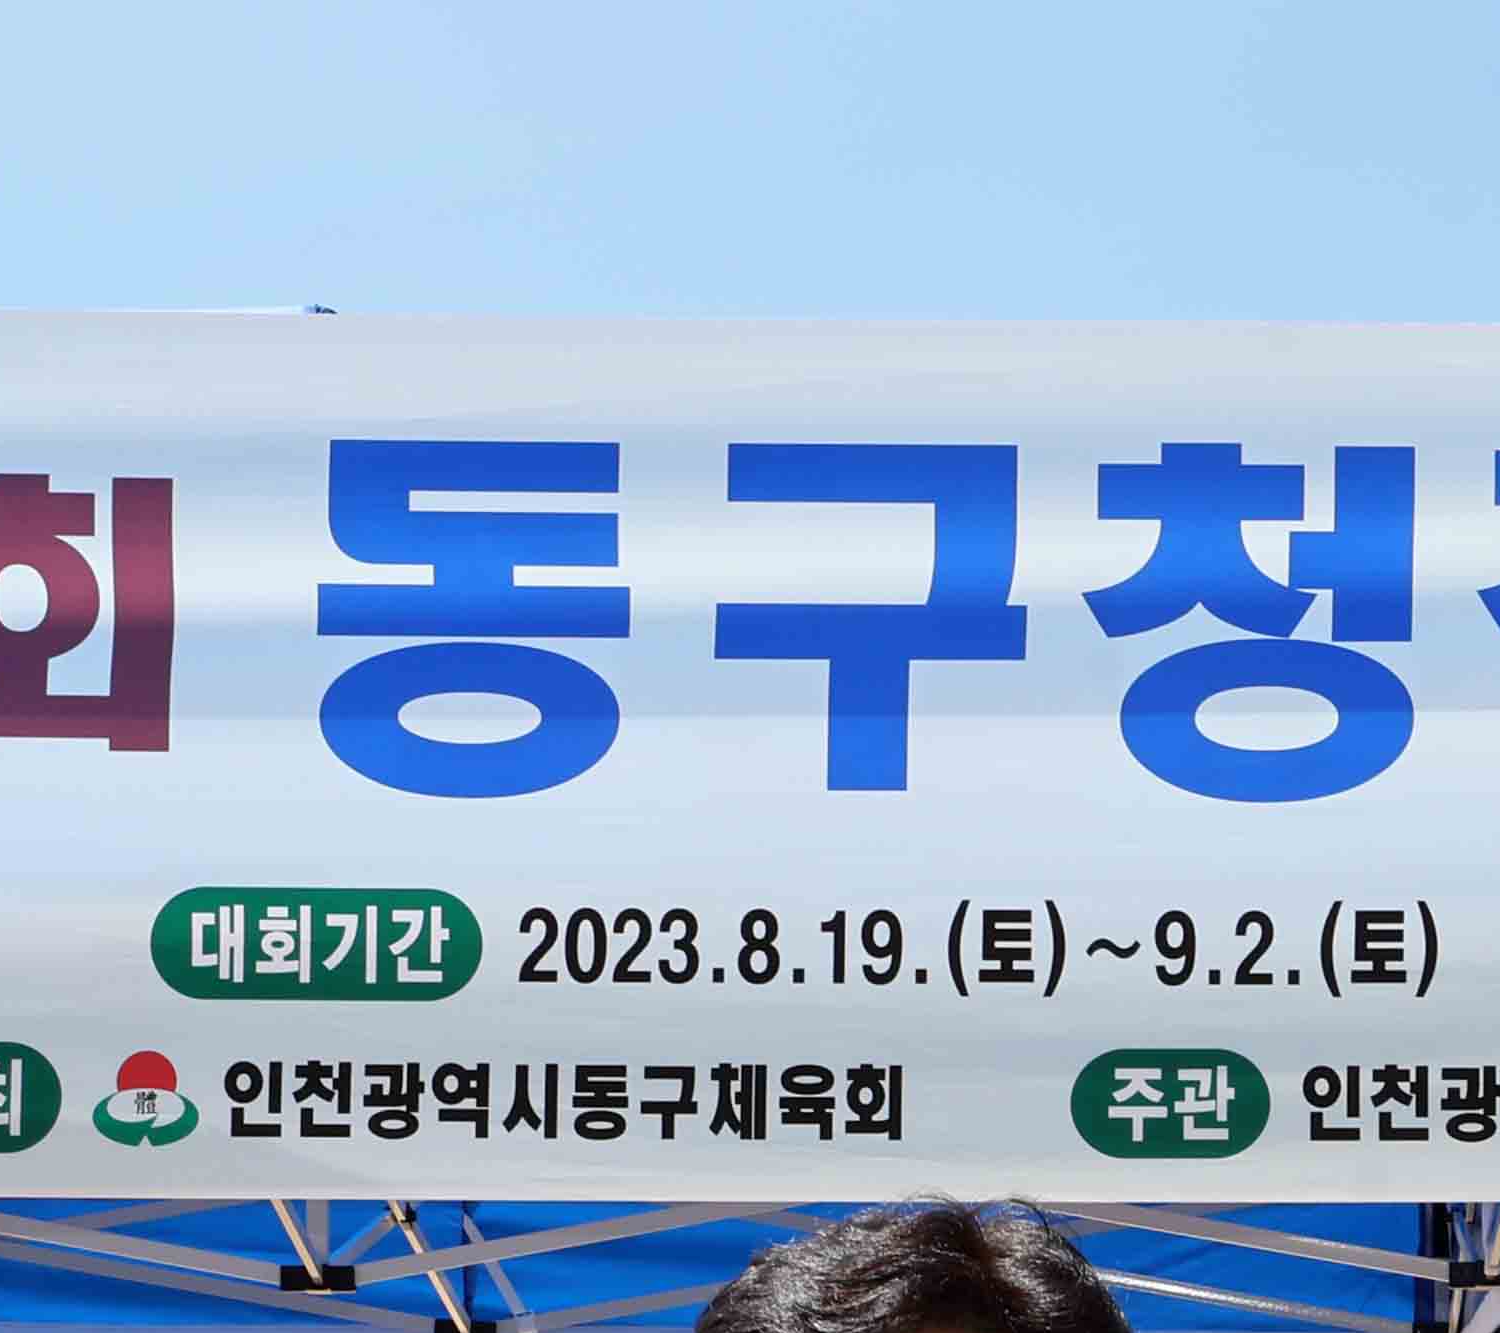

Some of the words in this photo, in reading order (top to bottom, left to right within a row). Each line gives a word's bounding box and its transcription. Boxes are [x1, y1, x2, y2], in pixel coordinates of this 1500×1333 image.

[191, 904, 450, 983] 대회기간
[225, 1060, 903, 1141] 인천광역시동구체육회
[1108, 1065, 1235, 1142] 주관
